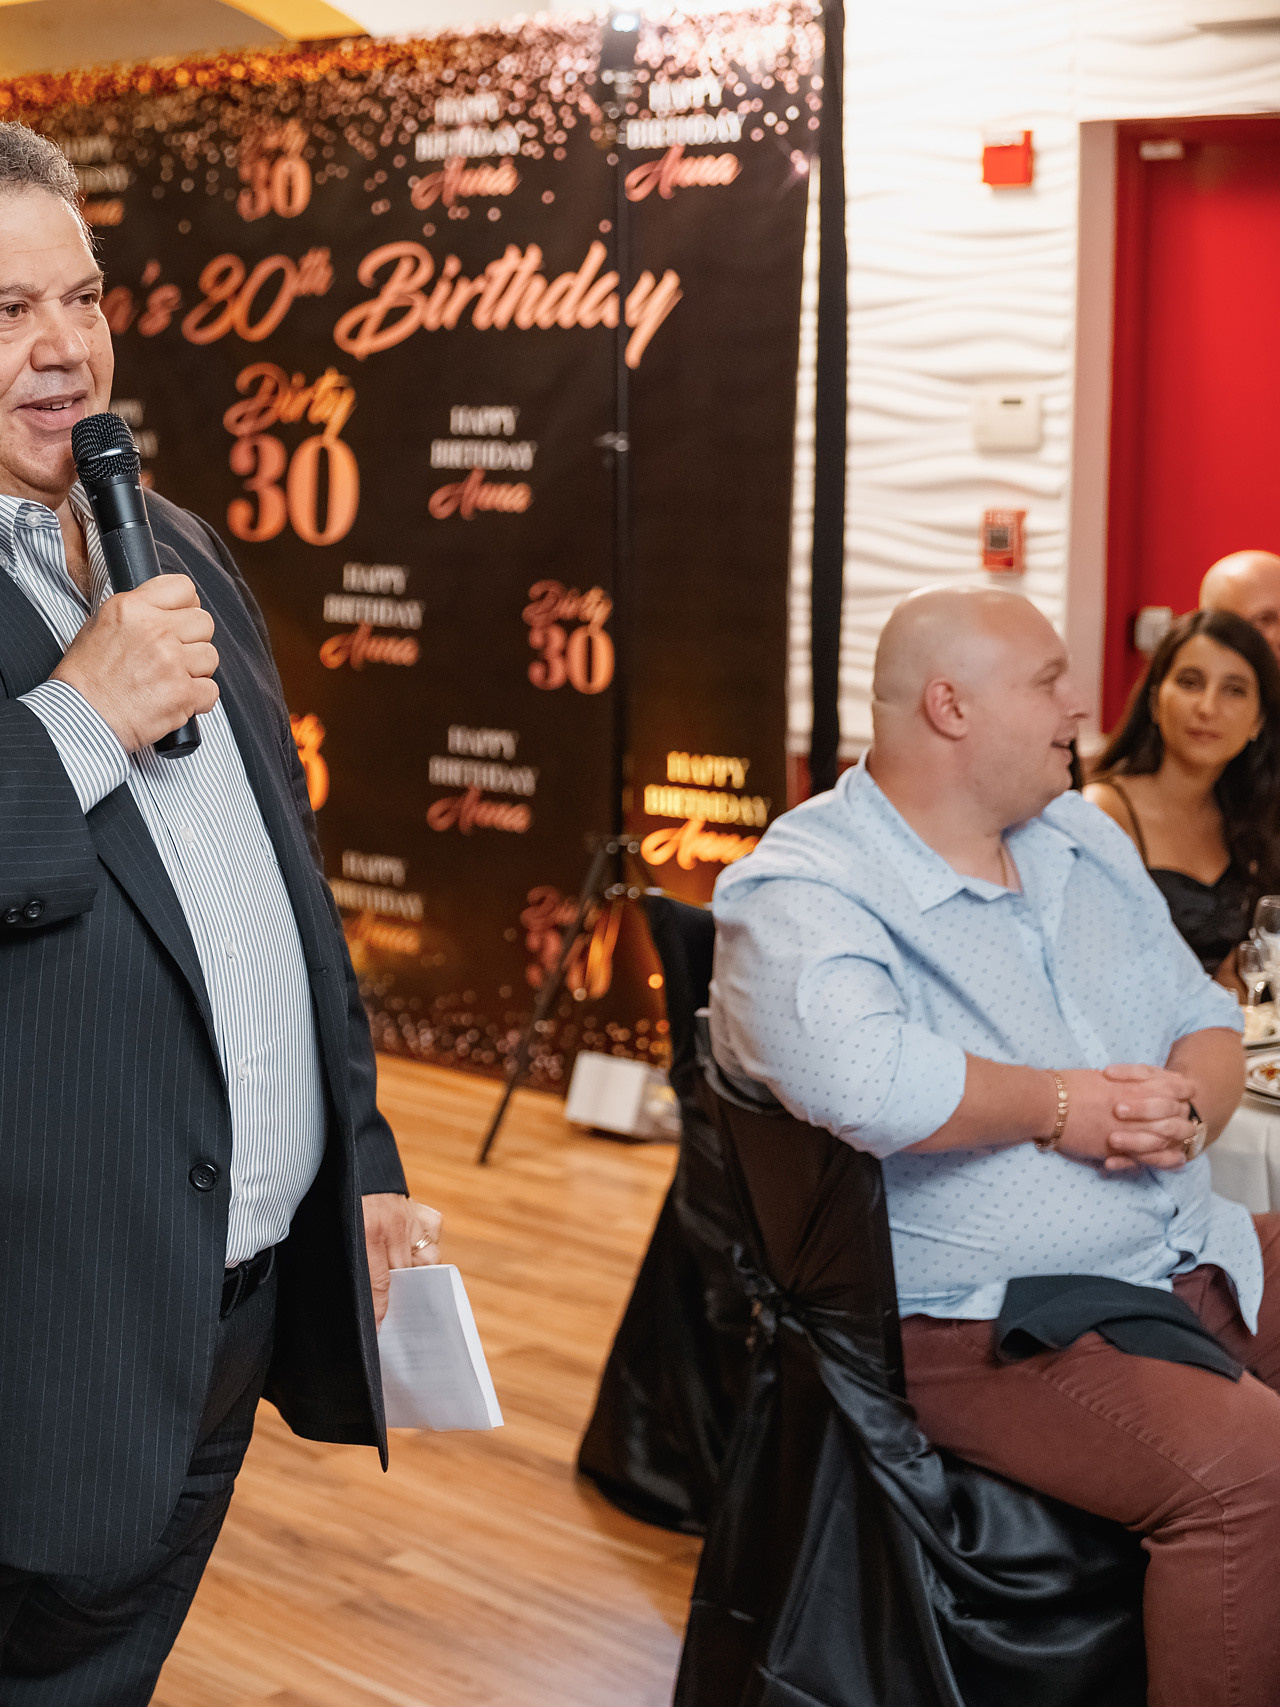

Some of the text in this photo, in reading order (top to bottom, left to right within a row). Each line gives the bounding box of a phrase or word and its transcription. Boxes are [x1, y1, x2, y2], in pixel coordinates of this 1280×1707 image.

[333, 240, 684, 369] Birthday
[227, 433, 361, 546] 30
[528, 624, 615, 695] 30
